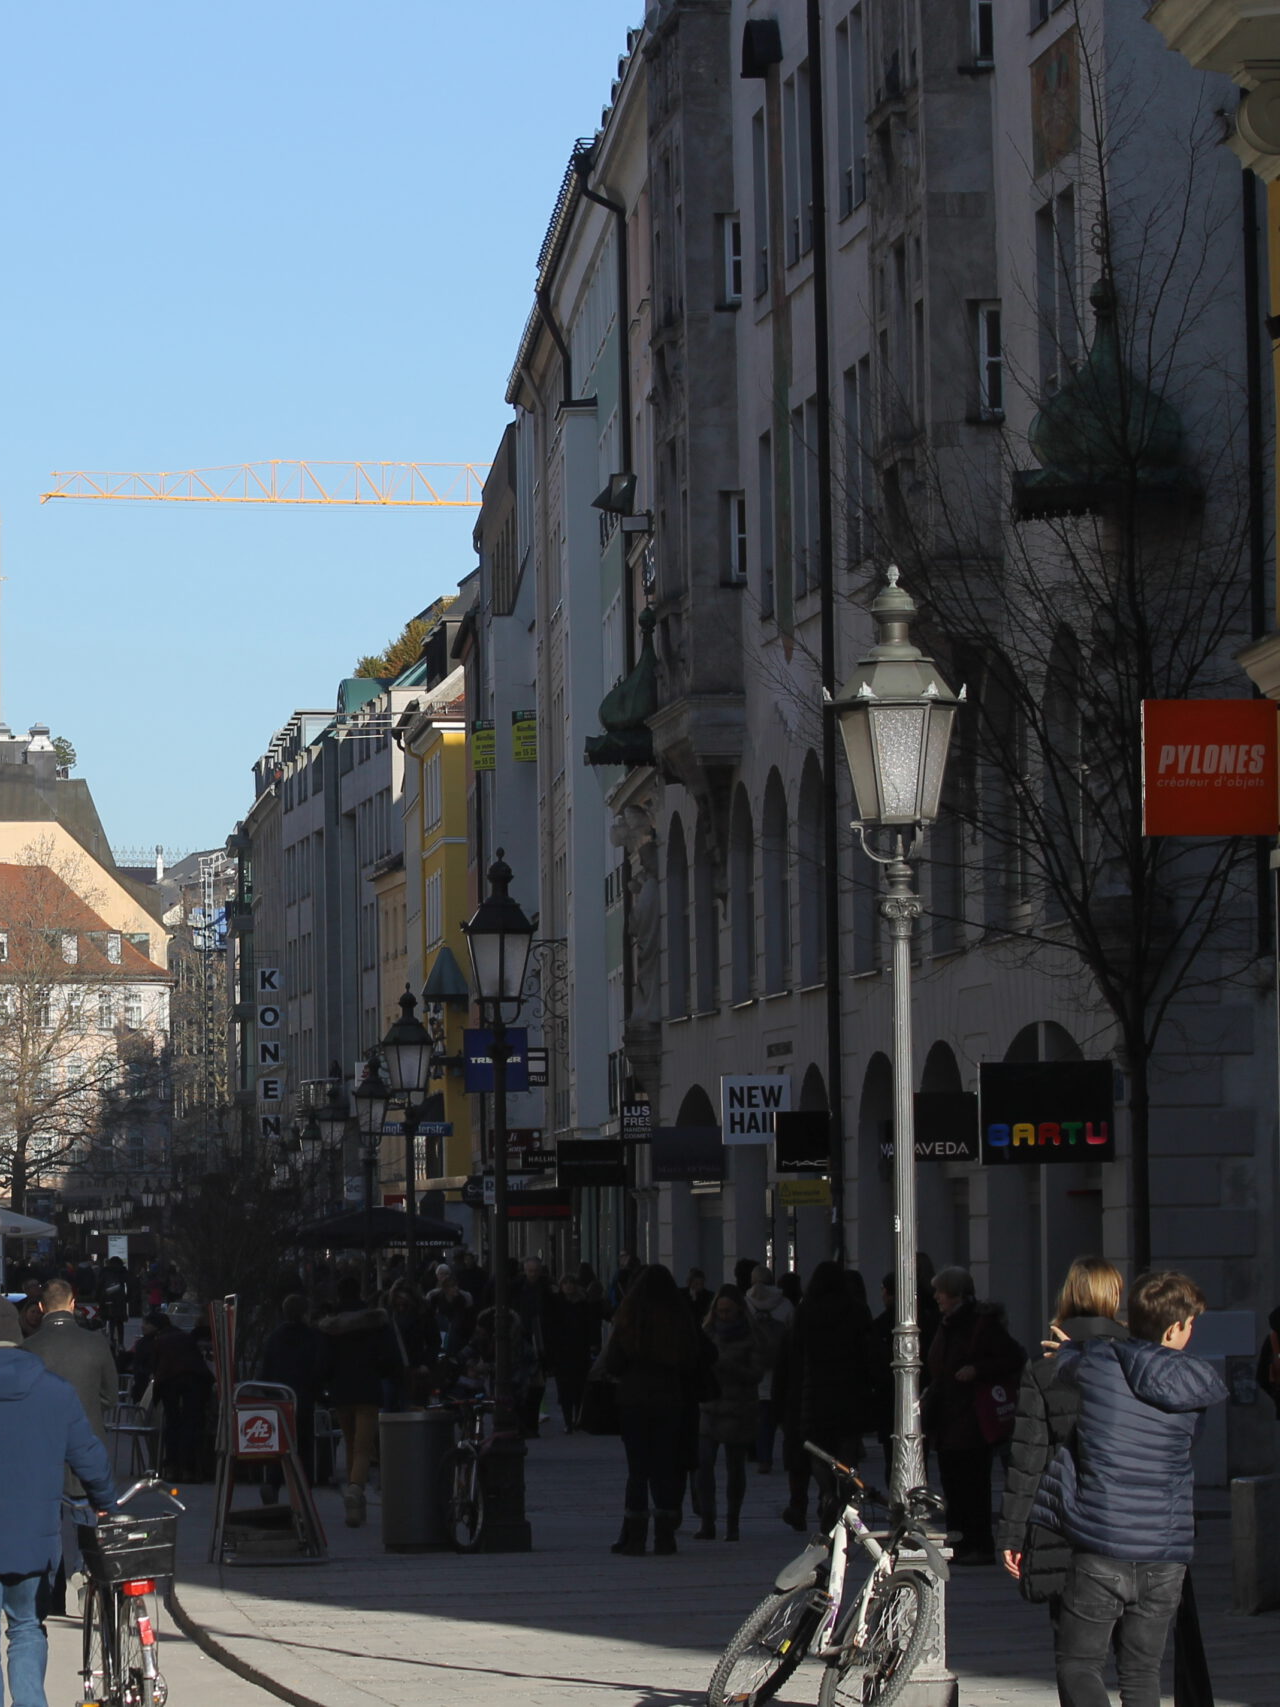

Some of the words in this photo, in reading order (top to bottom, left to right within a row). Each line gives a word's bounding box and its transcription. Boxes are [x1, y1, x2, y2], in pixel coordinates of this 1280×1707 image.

[1157, 743, 1266, 774] PYLONES
[1156, 776, 1209, 787] créateur
[1214, 775, 1265, 789] d'objets
[470, 1055, 522, 1064] TREER
[729, 1085, 783, 1109] NEW
[623, 1105, 650, 1116] LUS
[623, 1117, 652, 1126] FRES
[987, 1121, 1109, 1147] BARTU
[913, 1141, 969, 1155] AVEDA
